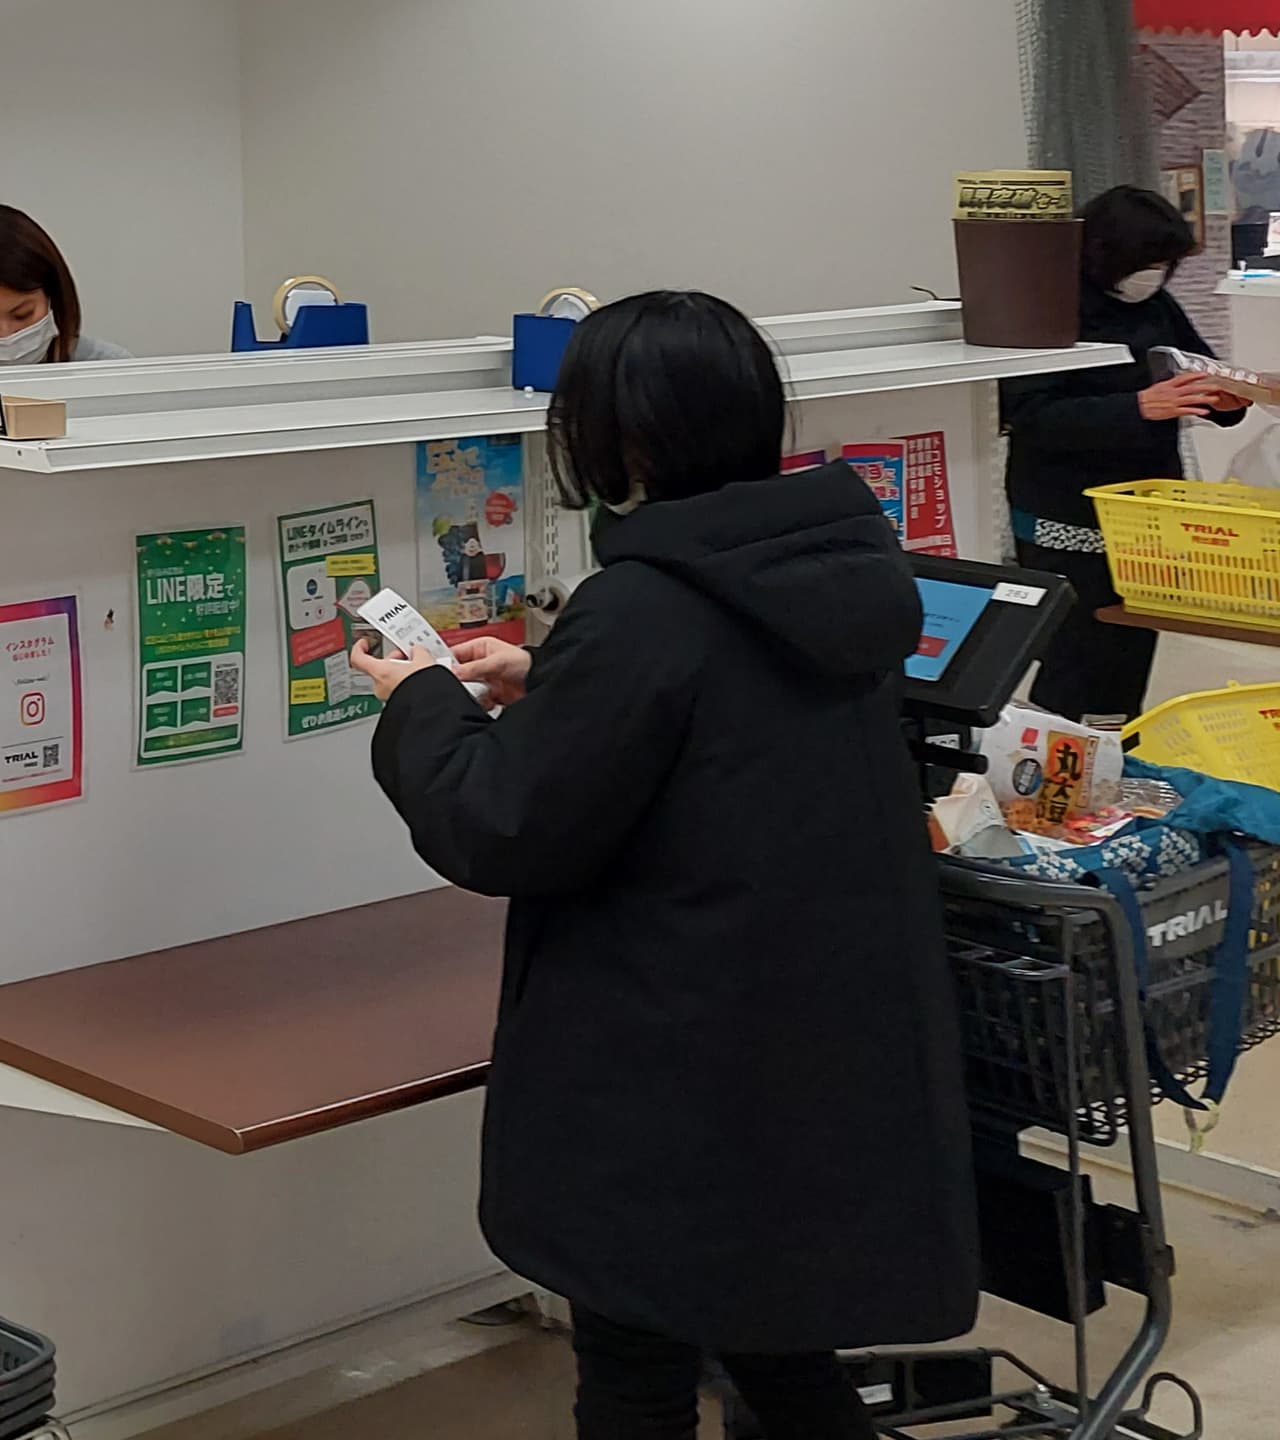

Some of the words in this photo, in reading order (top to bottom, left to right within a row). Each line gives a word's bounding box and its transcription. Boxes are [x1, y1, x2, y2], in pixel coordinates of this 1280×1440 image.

[1180, 522, 1239, 537] TRIAL
[146, 572, 236, 605] LINE限定で
[378, 603, 408, 625] TRIAL
[5, 751, 39, 764] TRIAL
[1047, 742, 1082, 824] 丸大豆
[1147, 900, 1228, 947] TRIAL
